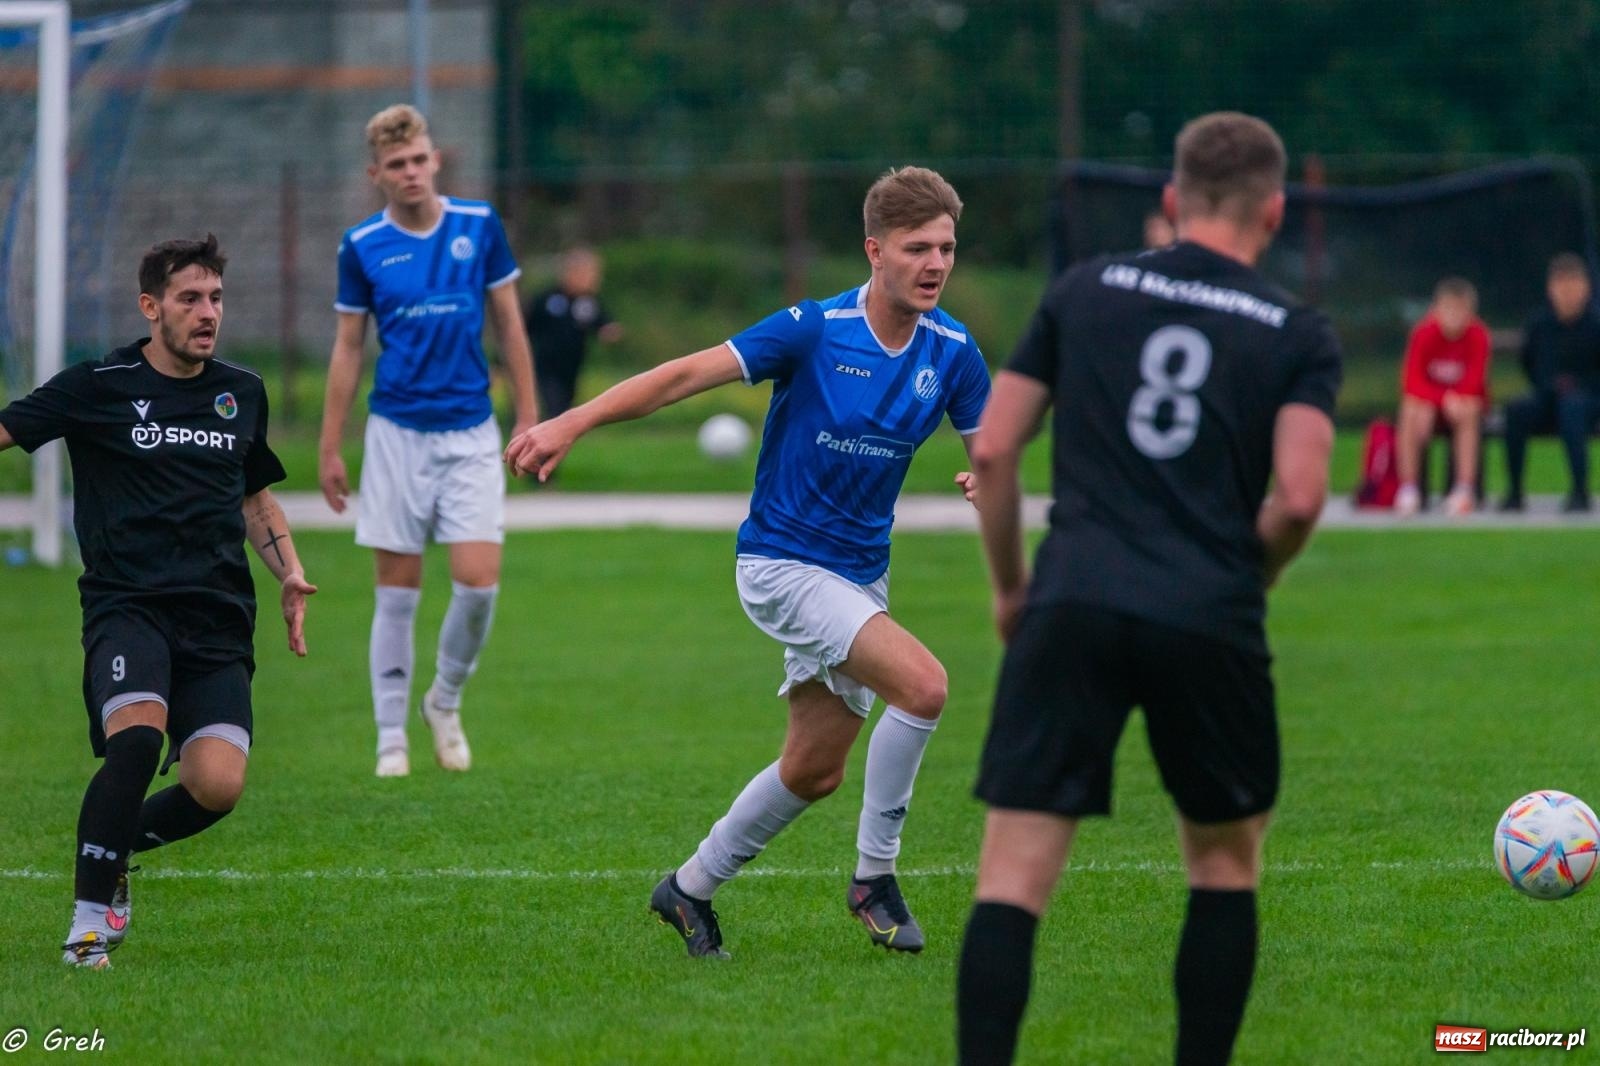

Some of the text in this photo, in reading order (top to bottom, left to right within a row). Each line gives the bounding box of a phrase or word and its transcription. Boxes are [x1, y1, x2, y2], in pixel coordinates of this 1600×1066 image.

[835, 363, 872, 378] zina
[1126, 324, 1213, 460] 8
[165, 426, 236, 451] SPORT
[815, 430, 896, 458] Pati Trans
[112, 655, 125, 682] 9
